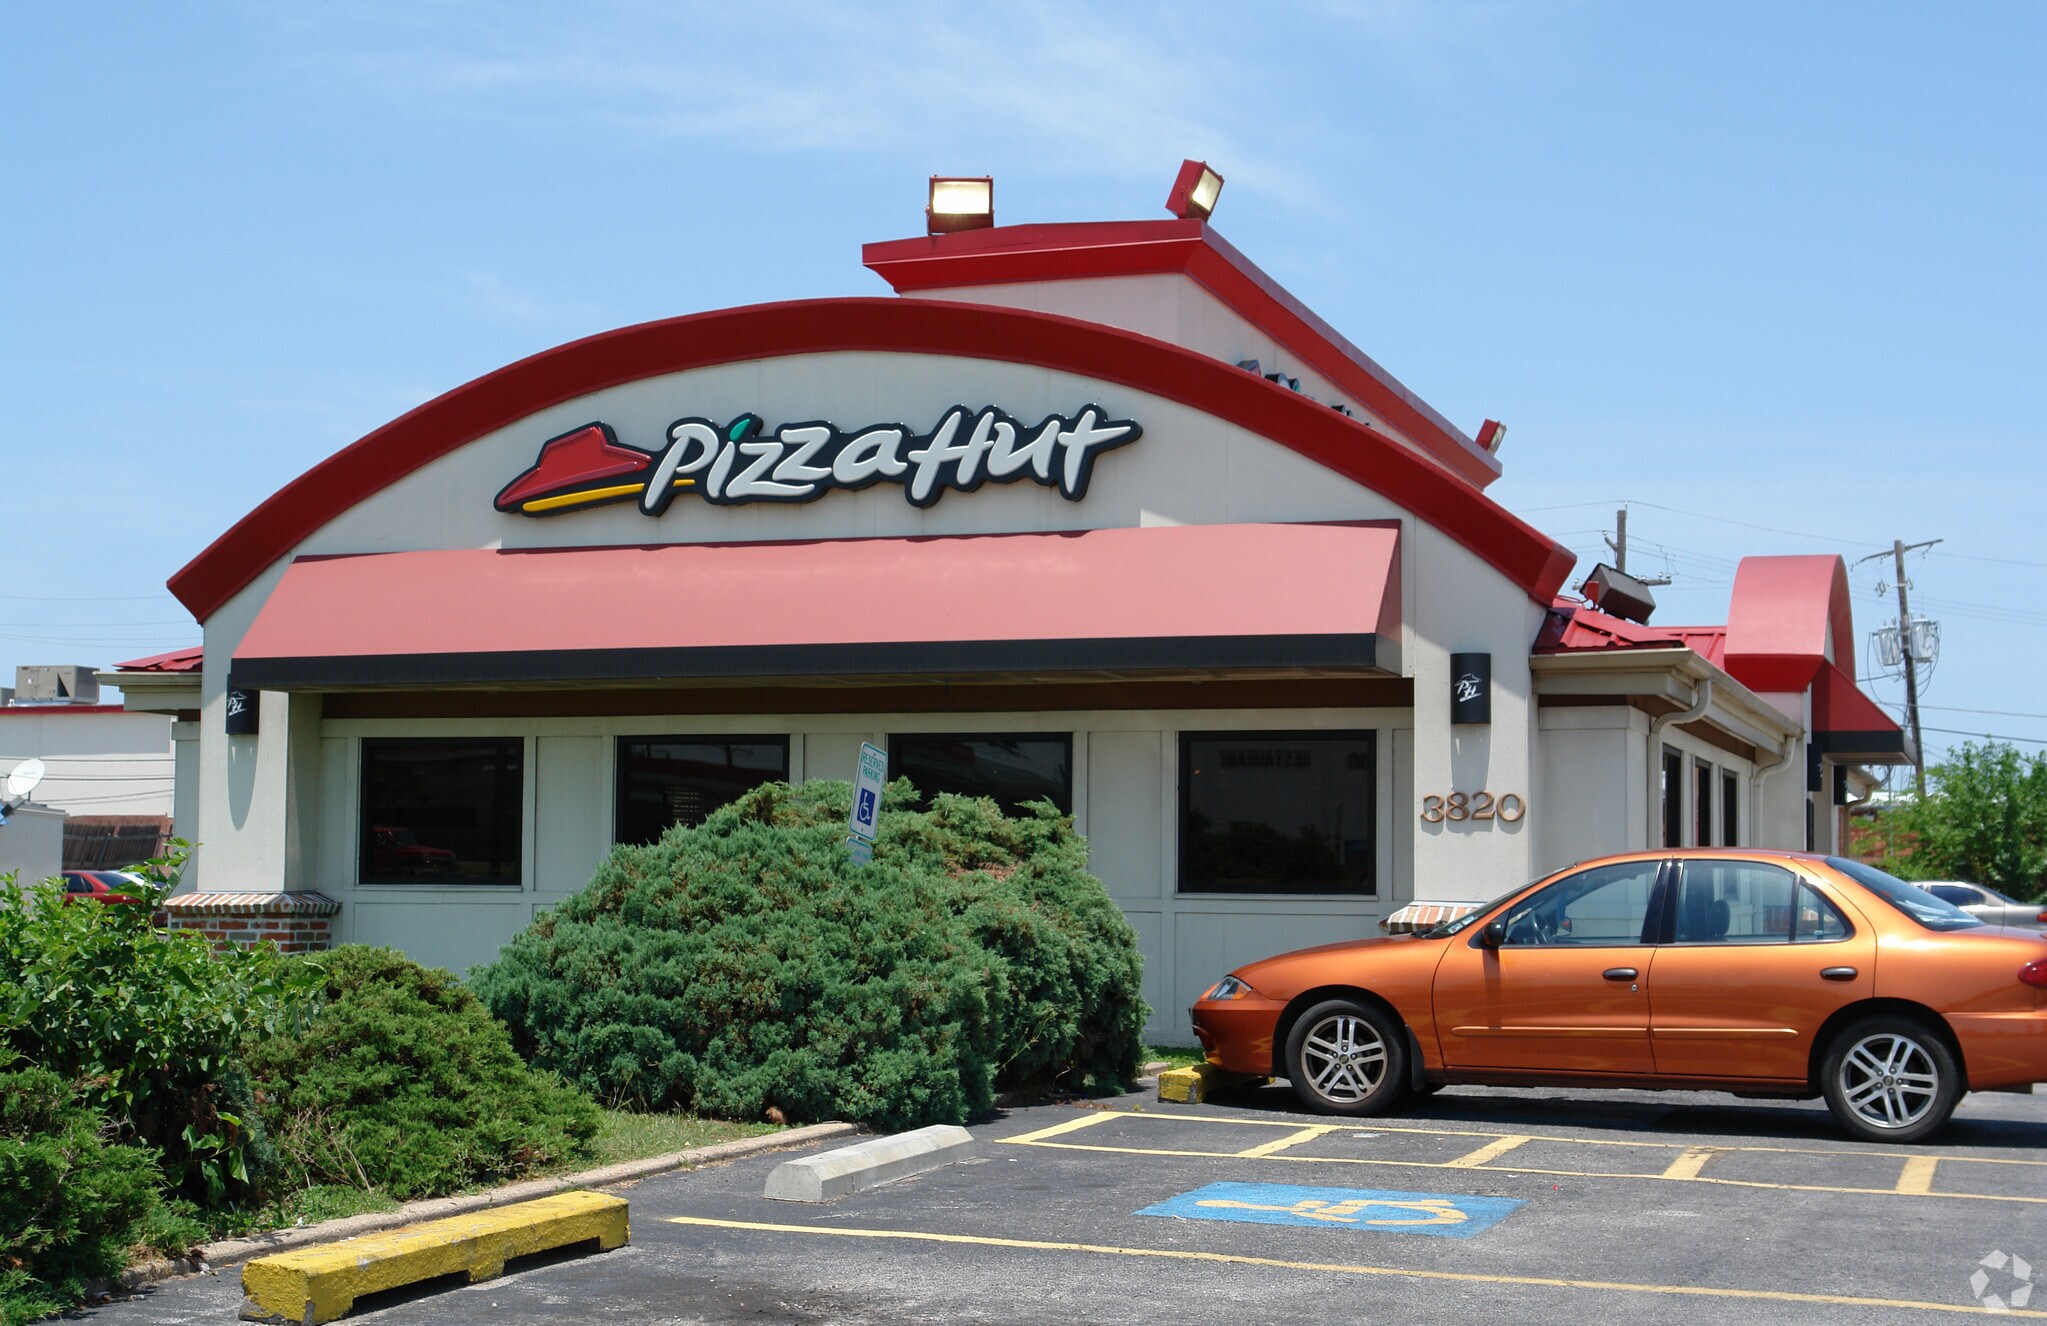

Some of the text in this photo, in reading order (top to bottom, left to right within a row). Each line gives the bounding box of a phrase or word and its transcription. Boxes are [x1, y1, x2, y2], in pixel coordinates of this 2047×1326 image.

[642, 409, 1133, 511] Pizza Hut
[862, 764, 880, 784] PARKING
[1420, 791, 1526, 823] 3820
